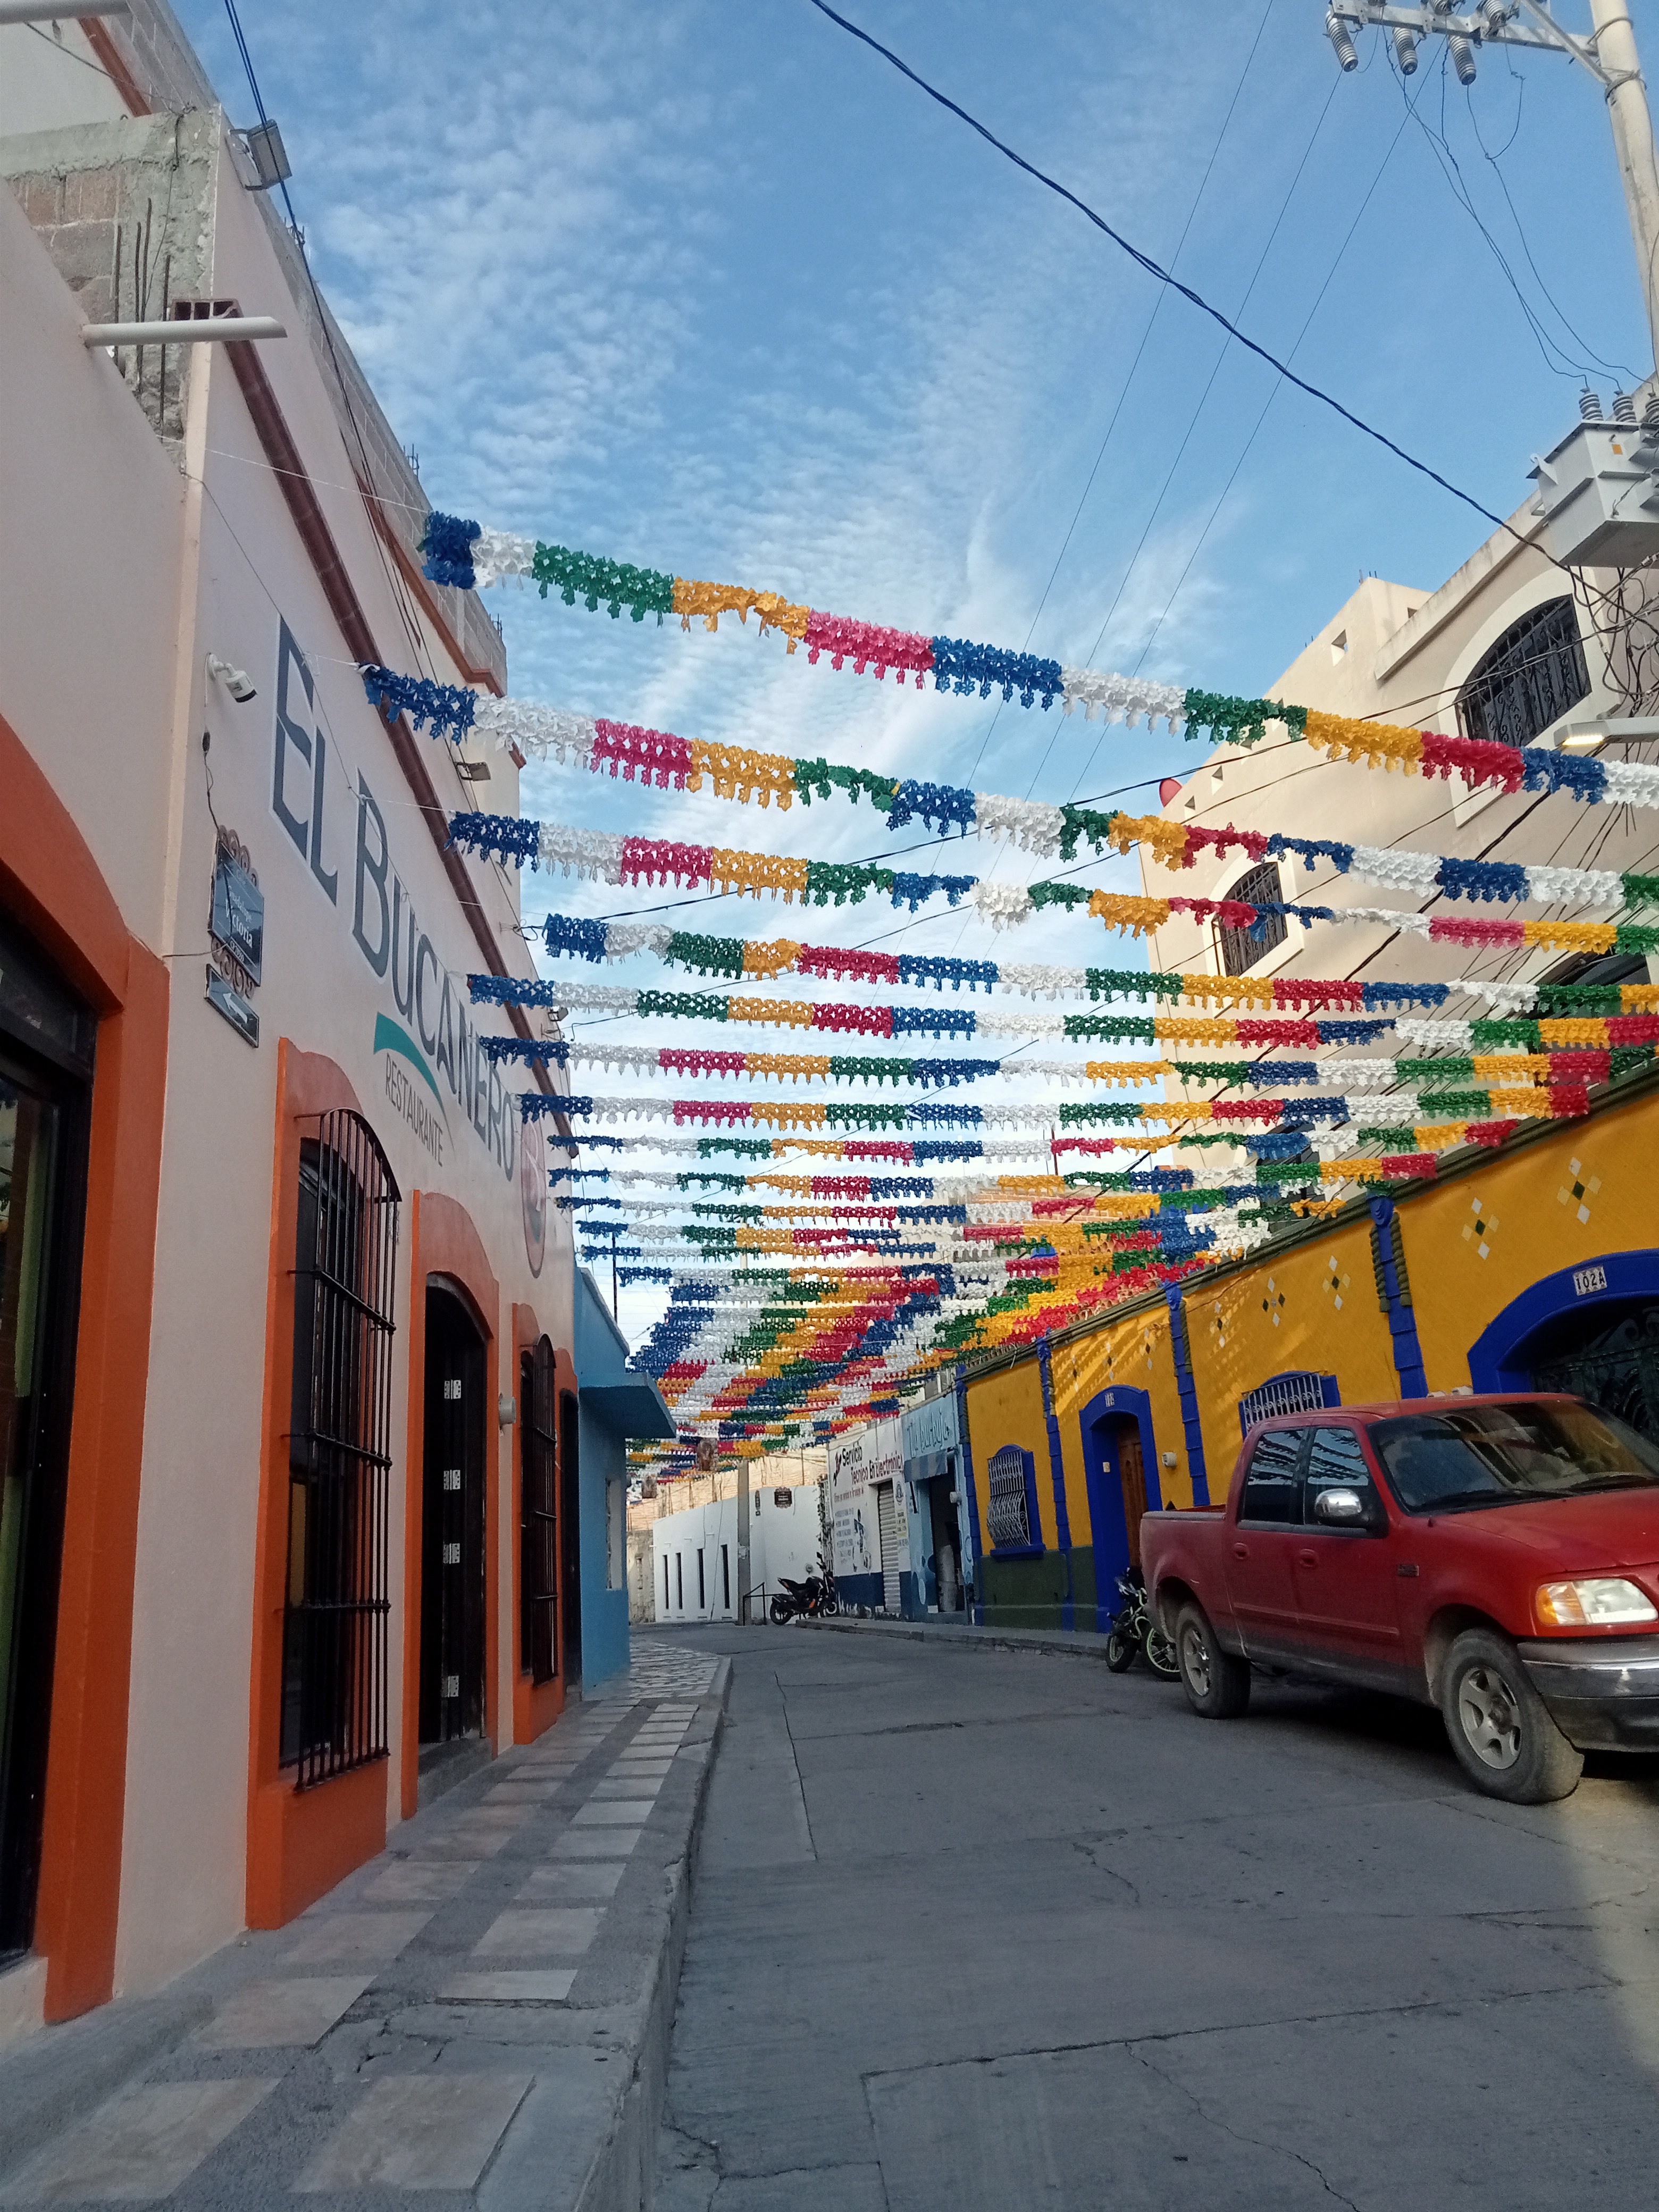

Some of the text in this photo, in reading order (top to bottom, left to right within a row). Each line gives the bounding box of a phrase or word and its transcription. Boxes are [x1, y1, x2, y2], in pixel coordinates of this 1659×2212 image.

[272, 614, 515, 1182] EL BUCANERO
[386, 1052, 442, 1167] RESTAURANTE
[1576, 1271, 1605, 1290] 102A
[842, 1441, 862, 1467] Servicio
[869, 1459, 875, 1479] En
